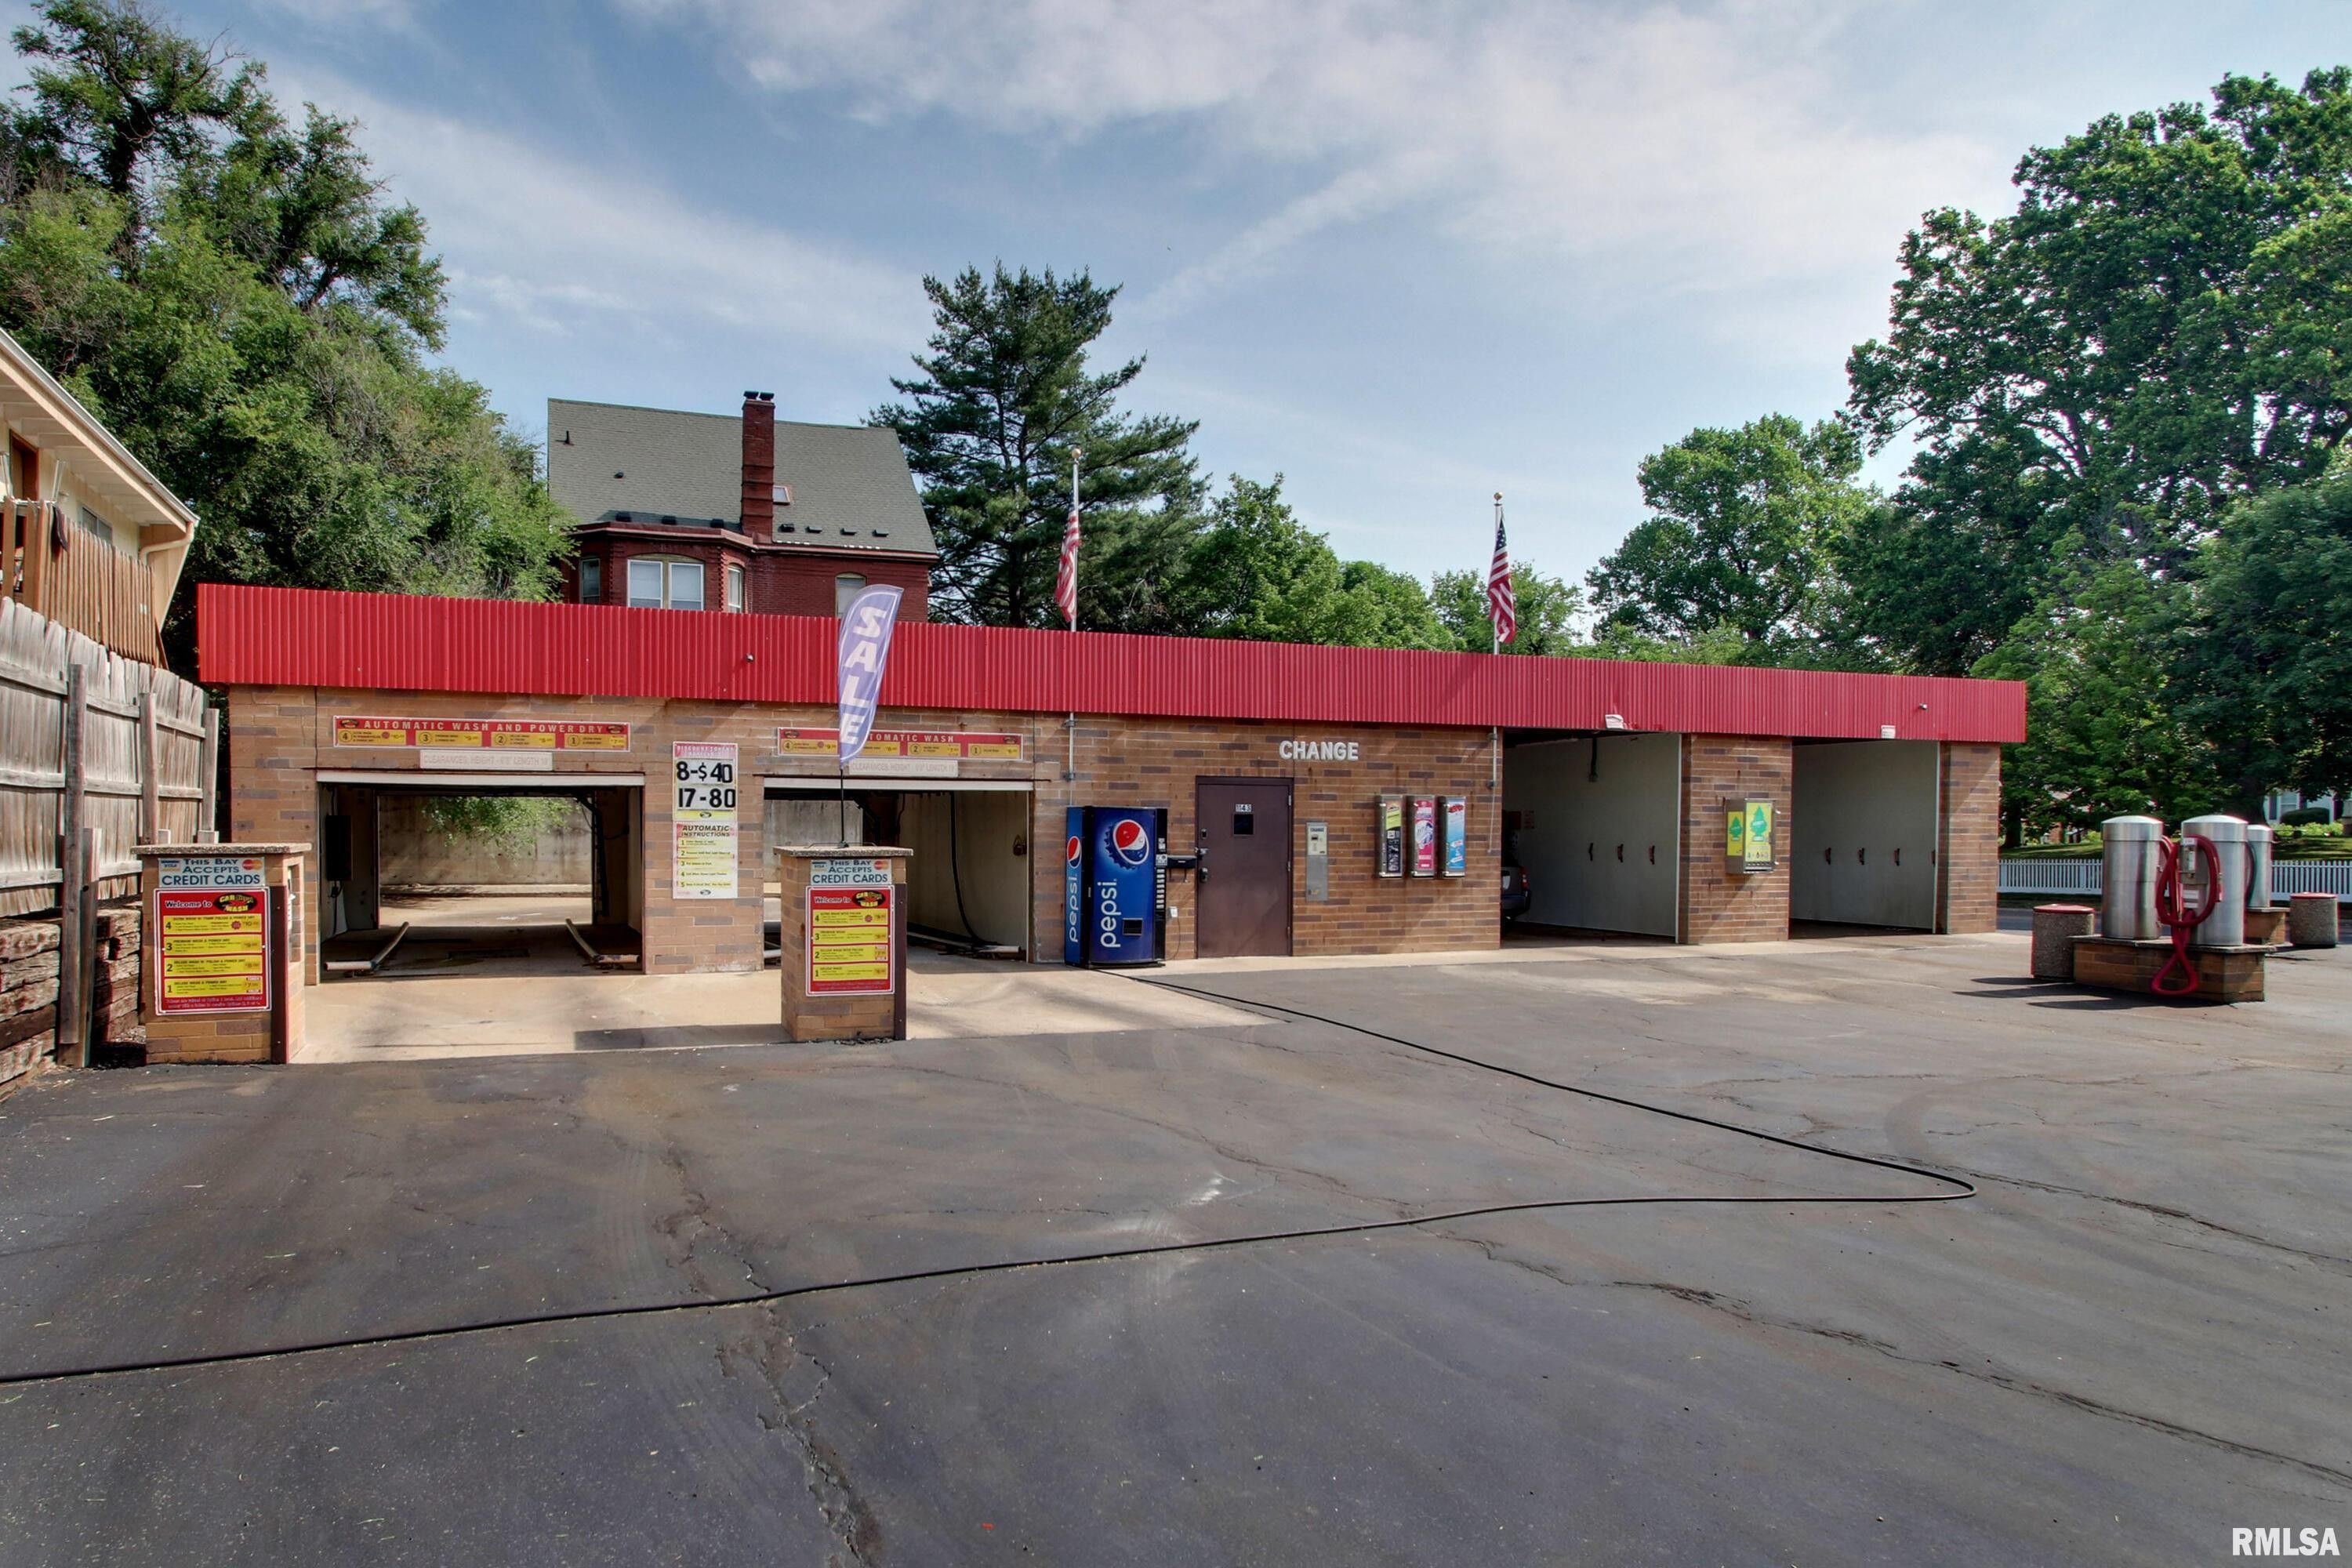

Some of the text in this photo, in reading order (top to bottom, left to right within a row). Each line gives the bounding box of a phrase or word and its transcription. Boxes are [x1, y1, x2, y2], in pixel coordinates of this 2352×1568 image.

[840, 606, 887, 744] SALE
[364, 720, 445, 730] AUTOMATIC
[452, 722, 488, 731] WASH
[530, 724, 574, 733] POWER
[1279, 740, 1359, 760] CHANGE
[162, 874, 260, 885] CREDIT CARDS
[812, 873, 888, 884] CREDIT CARDS
[1068, 876, 1079, 942] pepsi
[1098, 880, 1122, 948] pepsi
[165, 921, 172, 930] 4
[166, 942, 172, 951] 3
